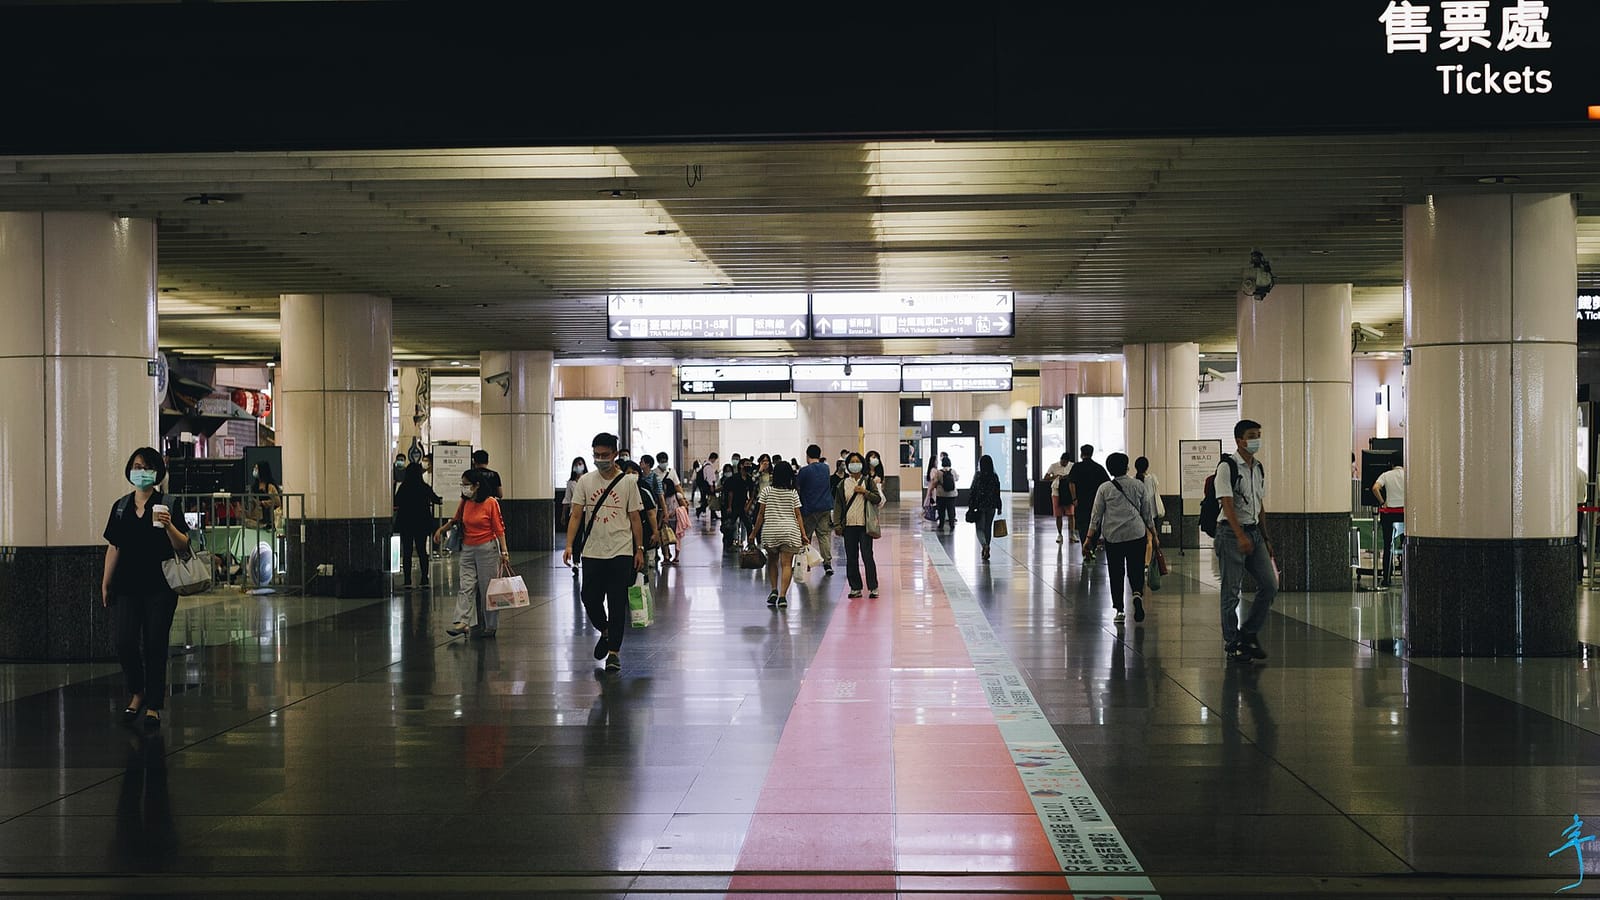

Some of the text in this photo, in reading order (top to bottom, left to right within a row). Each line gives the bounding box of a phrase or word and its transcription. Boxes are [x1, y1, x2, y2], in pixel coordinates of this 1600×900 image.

[1378, 0, 1552, 54] 售票處
[1436, 63, 1552, 94] Tickets
